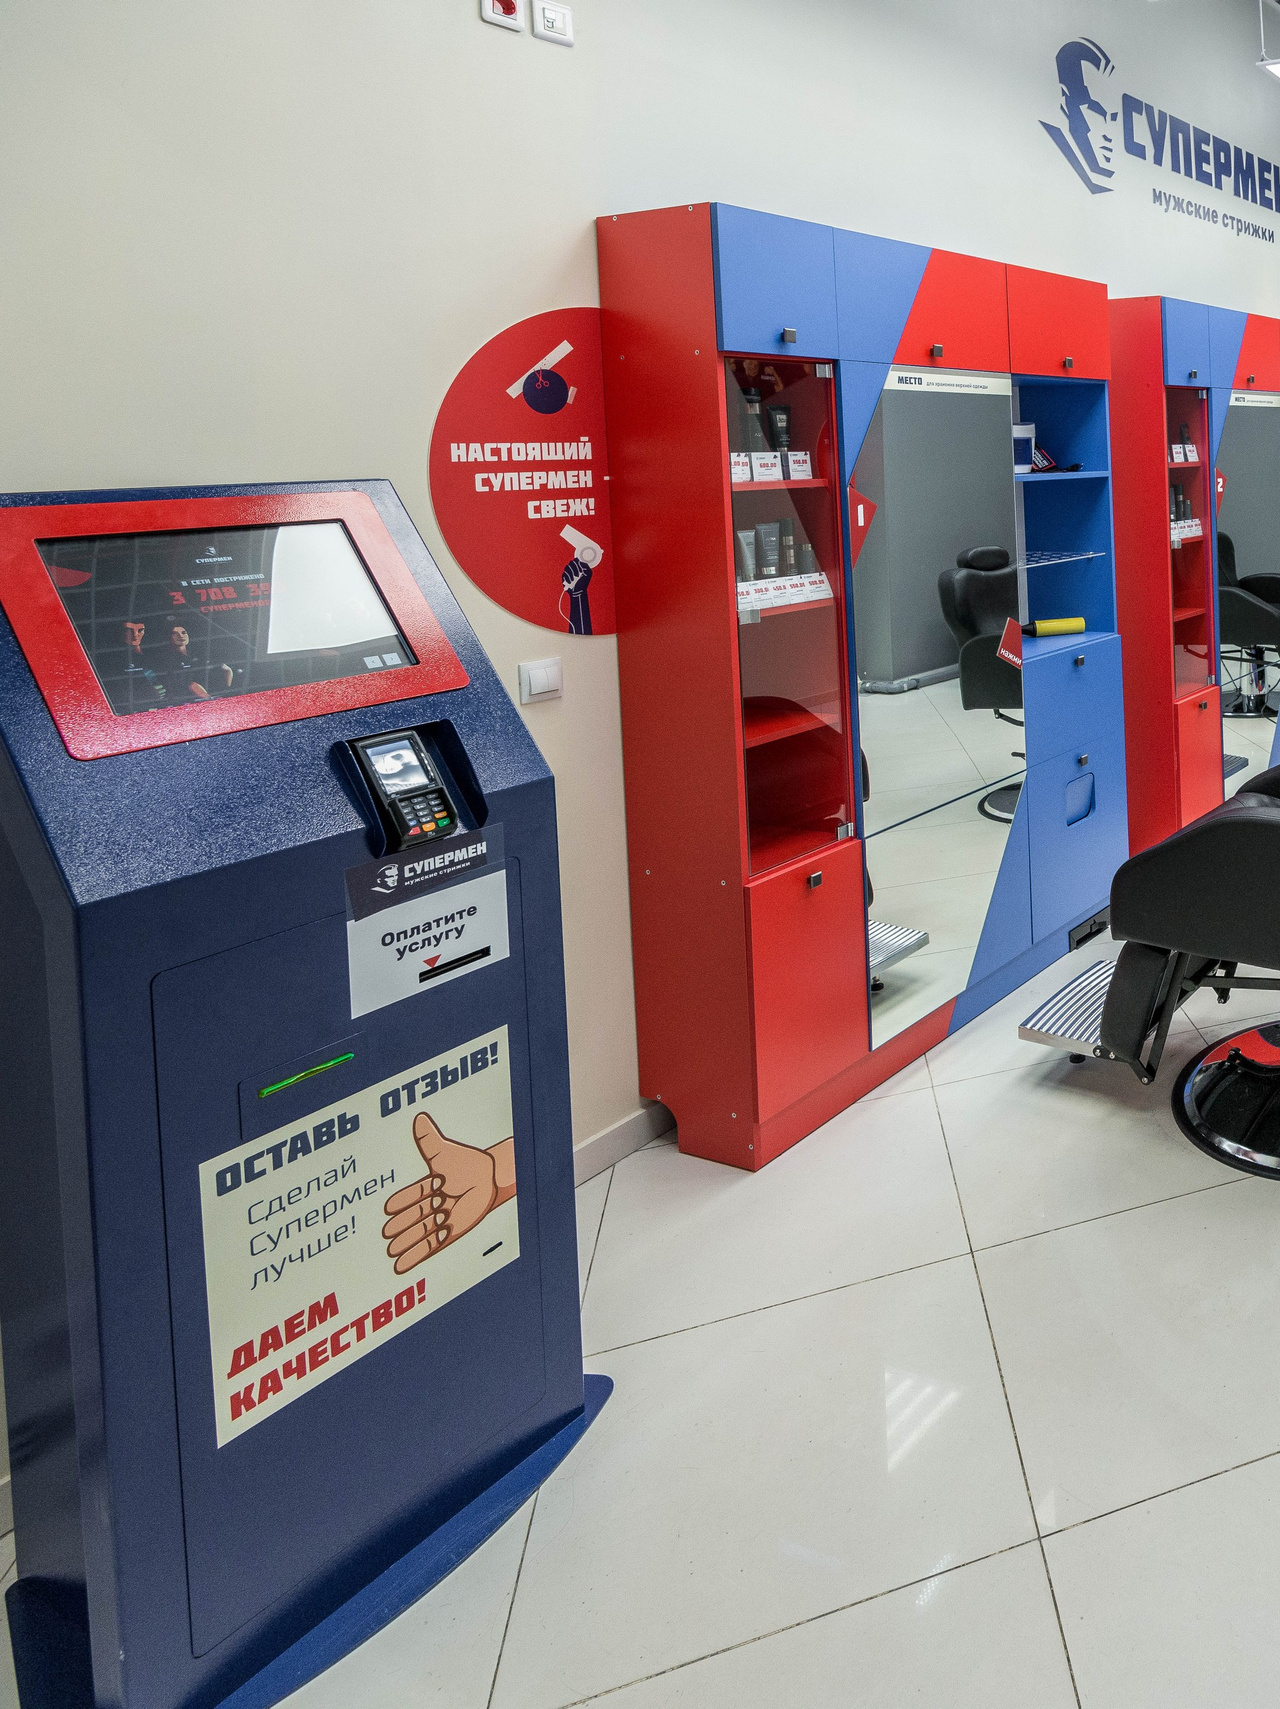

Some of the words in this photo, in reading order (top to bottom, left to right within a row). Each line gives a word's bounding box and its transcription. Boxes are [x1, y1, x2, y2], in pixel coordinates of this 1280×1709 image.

[1153, 188, 1218, 224] мужские
[1222, 213, 1275, 243] стрижки
[898, 376, 922, 385] МЕСТО
[451, 437, 592, 462] НАСТОЯЩИЙ
[475, 470, 593, 492] СУПЕРМЕН
[1217, 478, 1223, 492] 2
[528, 498, 595, 519] СВЕЖ!
[858, 504, 864, 526] 1
[195, 556, 232, 564] СУПЕРМЕН
[214, 574, 265, 583] ПОСТРИЖЕНО
[169, 591, 186, 605] 3
[195, 586, 237, 602] 708
[246, 582, 271, 596] 39
[1000, 648, 1022, 665] нажми
[404, 842, 487, 878] СУПЕРМЕН
[404, 872, 438, 886] мужские
[439, 862, 471, 876] стрижки
[381, 905, 477, 946] Оплатите
[395, 924, 466, 961] услугу
[216, 1112, 360, 1197] ОСТАВЬ
[379, 1041, 499, 1118] ОТЗЫВ!
[247, 1155, 357, 1225] Сделай
[249, 1168, 395, 1257] Супермен
[251, 1216, 356, 1291] лучше!
[227, 1291, 339, 1380] ДАЕМ
[230, 1278, 426, 1421] КАЧЕСТВО!
